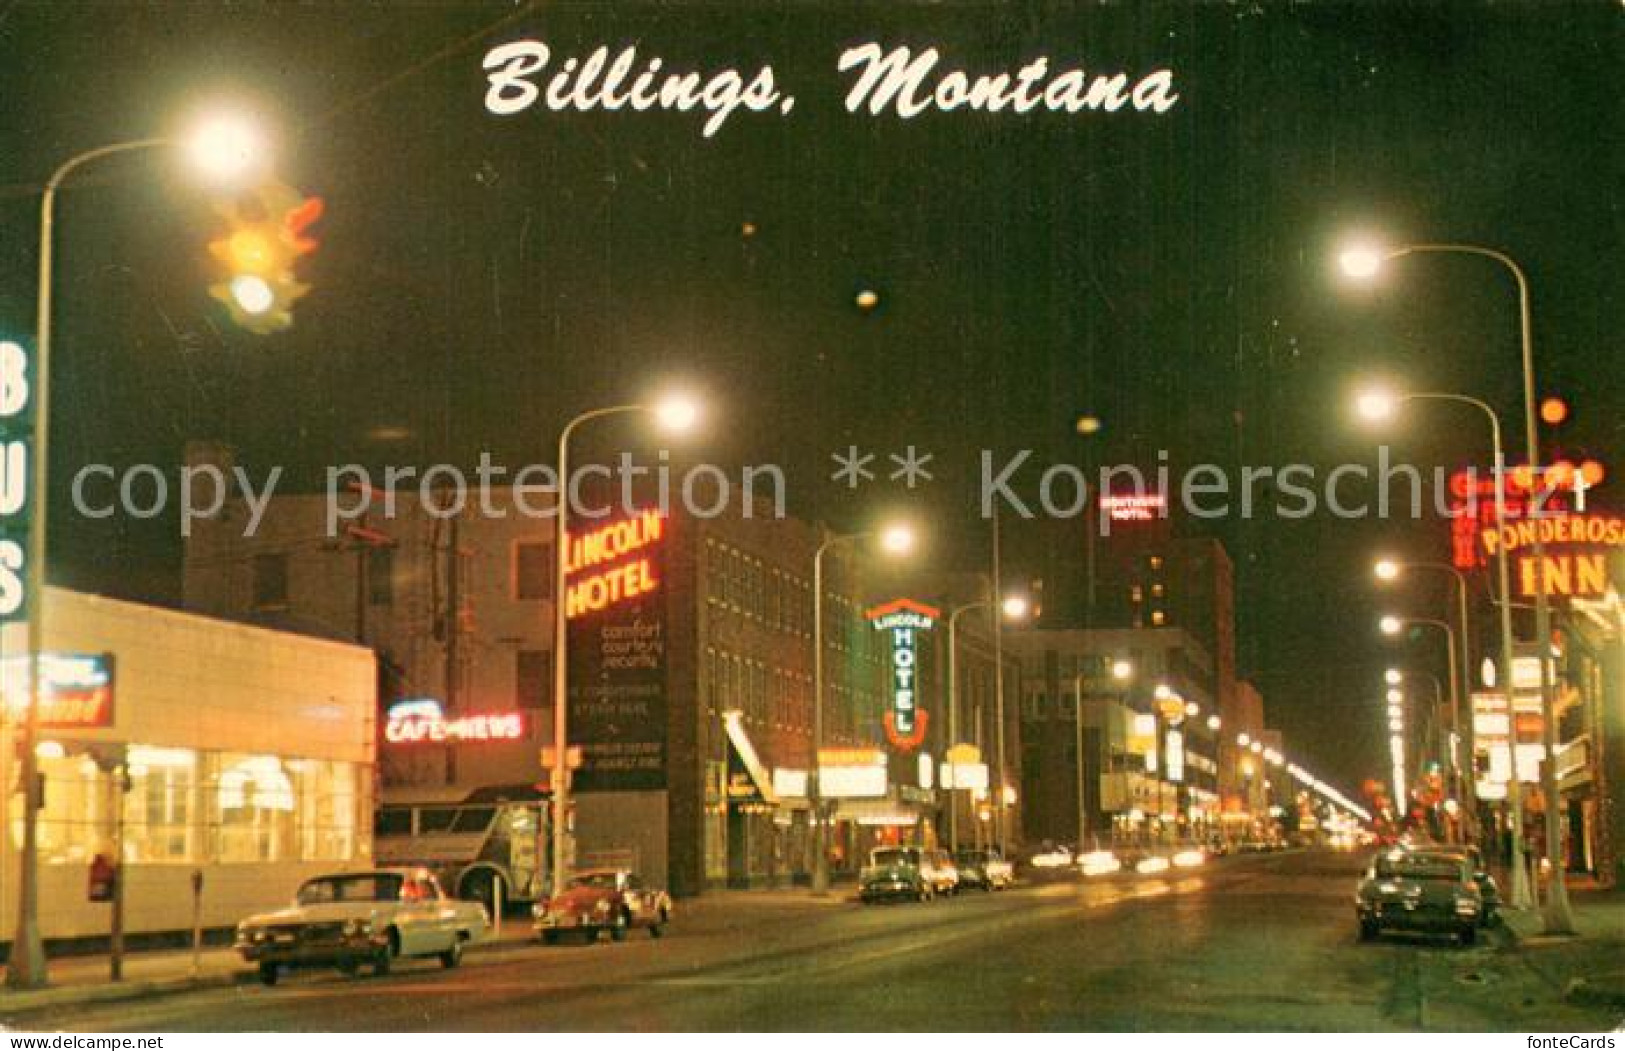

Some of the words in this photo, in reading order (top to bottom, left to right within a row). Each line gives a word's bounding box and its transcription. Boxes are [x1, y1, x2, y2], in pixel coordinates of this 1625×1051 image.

[564, 509, 662, 573] LINCOLN
[1482, 513, 1625, 555] PONDEROS
[566, 559, 657, 618] HOTEL
[1521, 554, 1606, 596] INN
[894, 628, 914, 733] HOTEL
